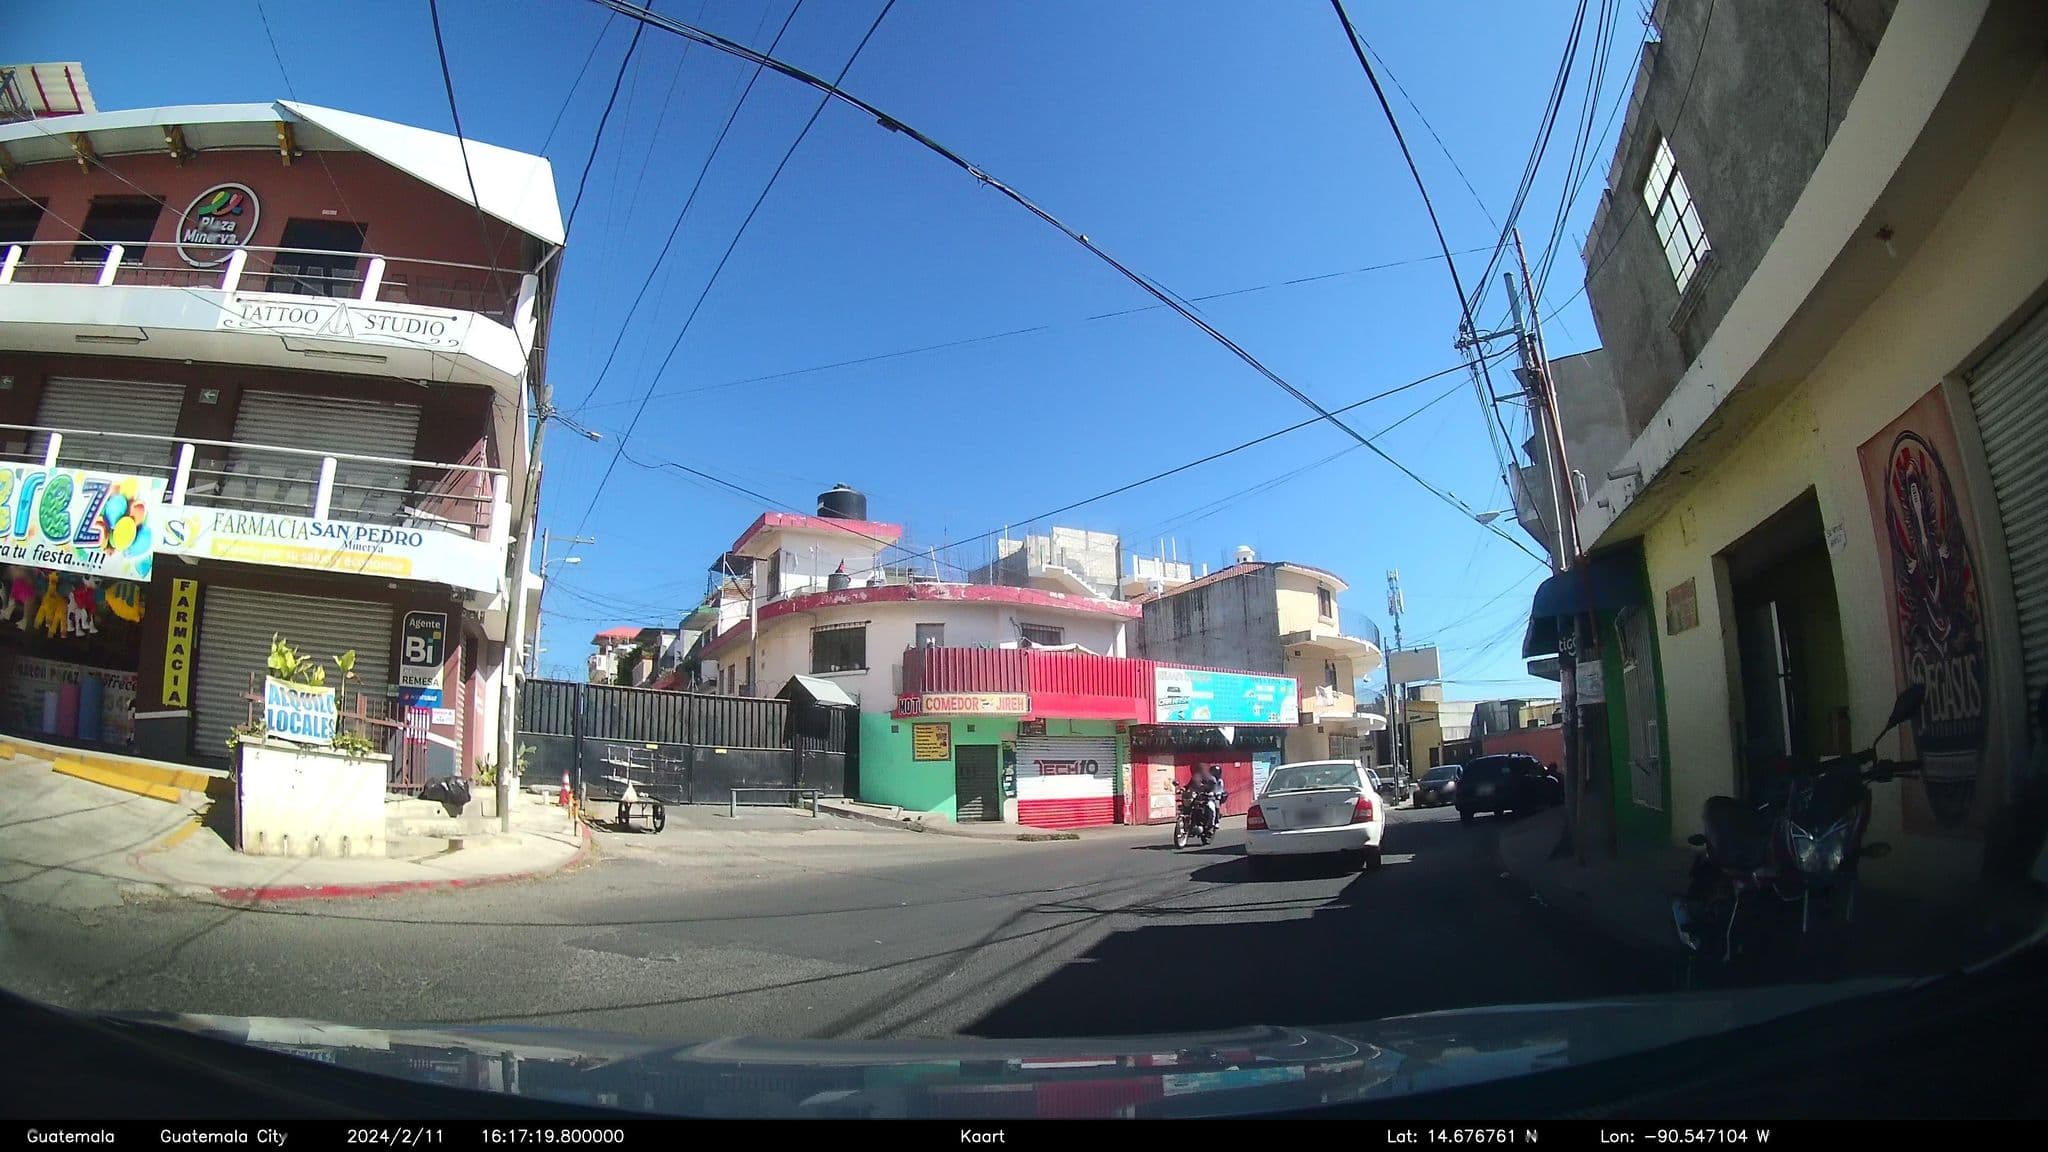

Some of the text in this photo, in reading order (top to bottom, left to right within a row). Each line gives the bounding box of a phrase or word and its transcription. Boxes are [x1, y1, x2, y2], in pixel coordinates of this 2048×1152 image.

[241, 304, 445, 336] TATTOO STUDIO
[213, 511, 424, 548] FARMACIA SAN PEDRO
[12, 545, 27, 559] tu
[343, 540, 385, 555] Minerva
[409, 618, 441, 630] Agente
[169, 581, 190, 703] FARMACIA
[405, 634, 434, 664] Bi
[402, 675, 440, 687] REMESA
[1911, 651, 1982, 734] PEGASUS
[926, 697, 979, 711] COMEDOR
[996, 697, 1024, 711] JIREH
[267, 707, 336, 739] LOCALES
